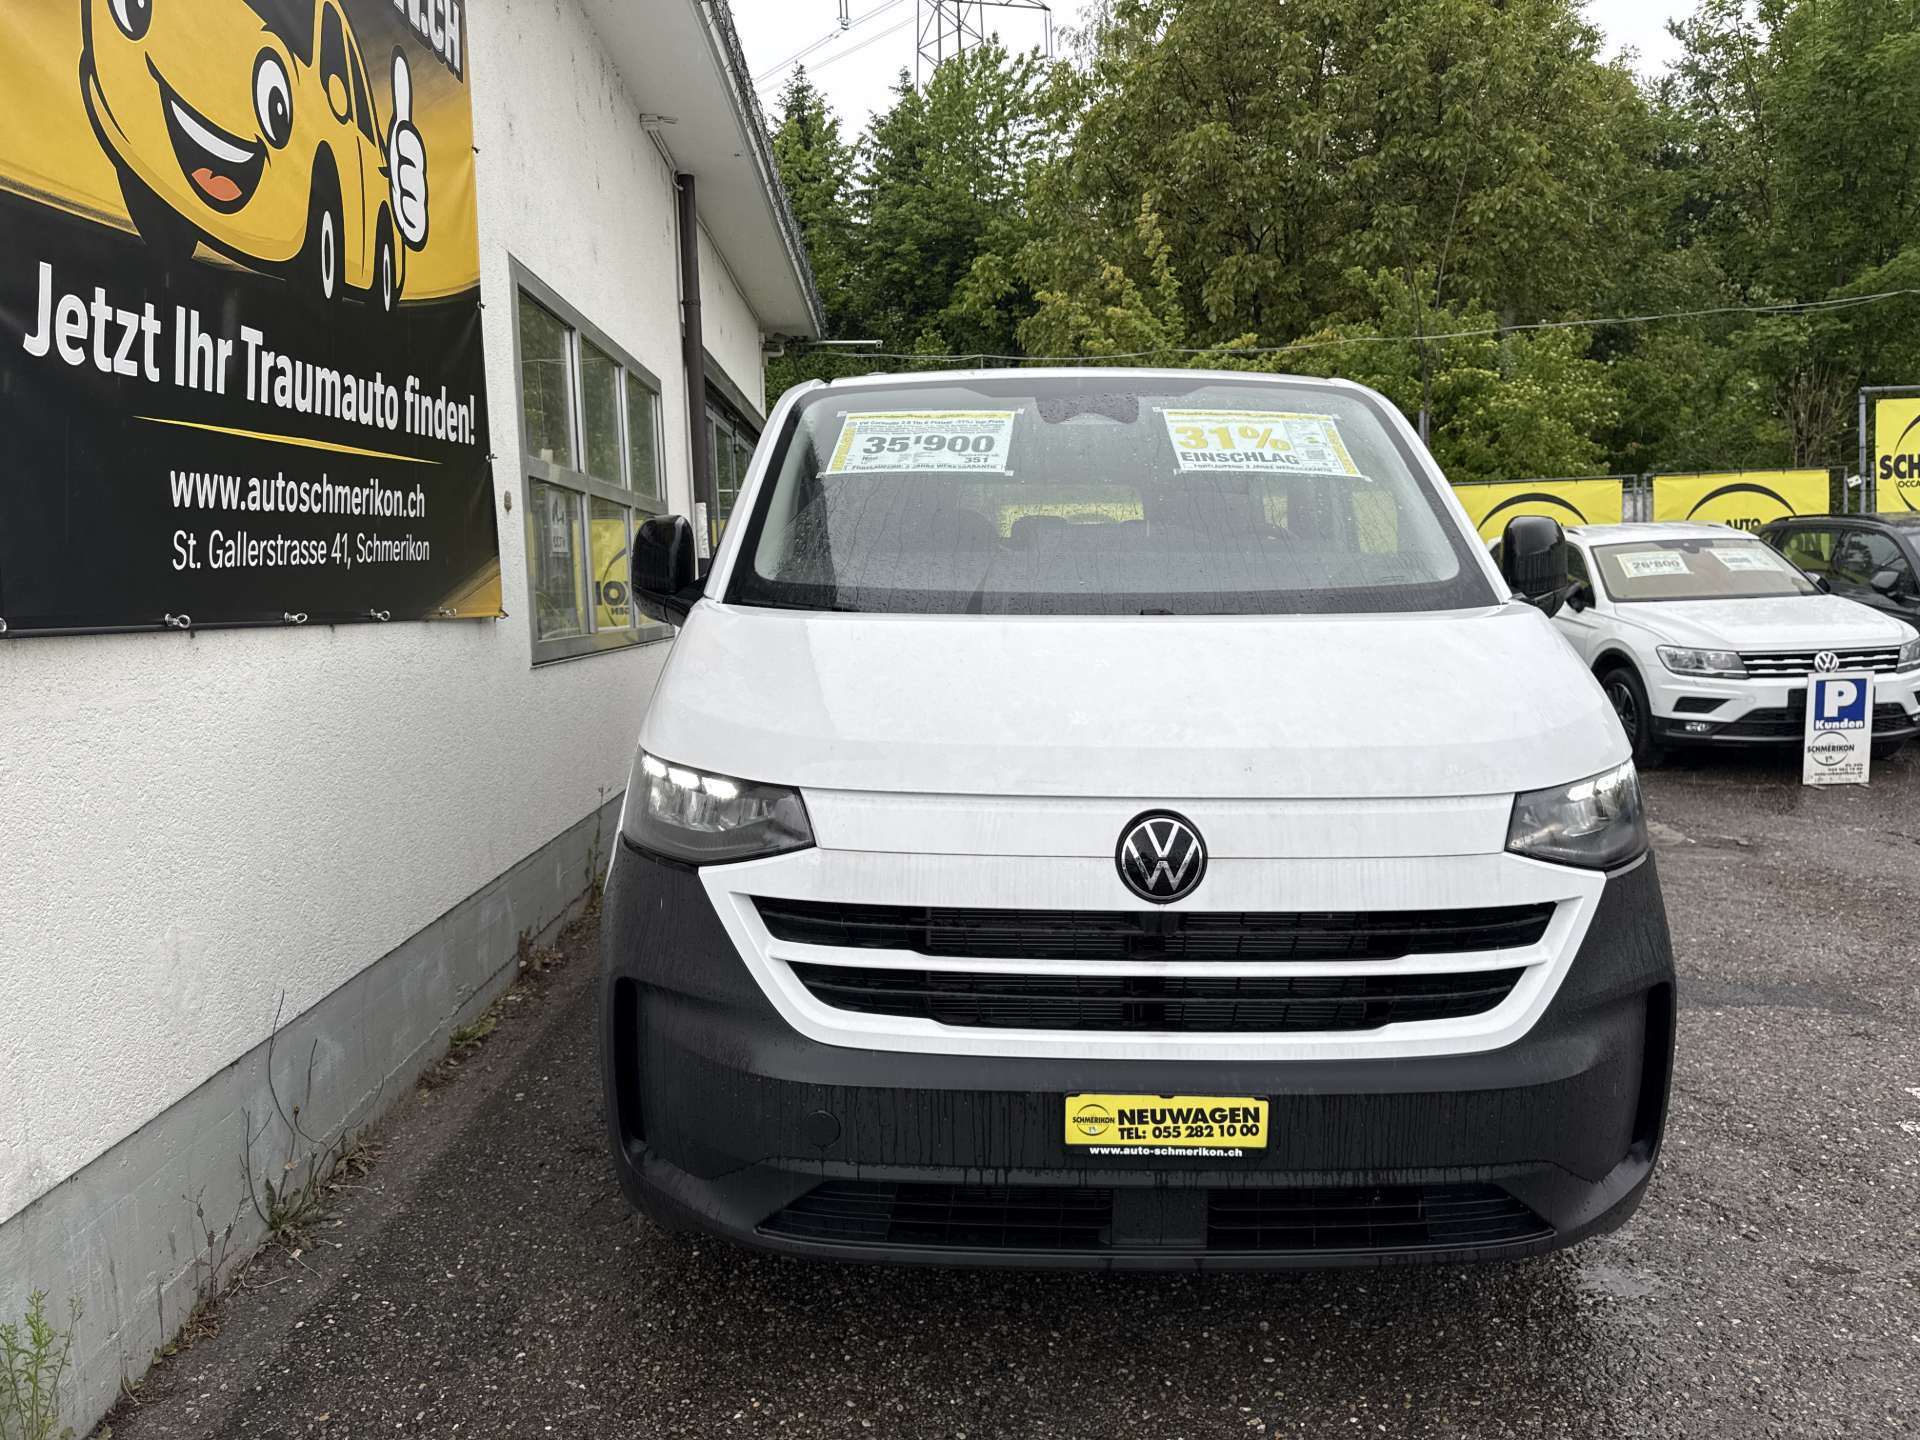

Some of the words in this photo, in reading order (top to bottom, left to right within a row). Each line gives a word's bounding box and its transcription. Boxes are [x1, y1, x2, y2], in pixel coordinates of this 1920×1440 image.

[23, 261, 162, 382] Jetzt
[175, 305, 233, 395] Ihr
[240, 325, 399, 430] Traumauto
[404, 374, 475, 445] finden!
[863, 435, 995, 454] 35'900
[1175, 425, 1292, 451] 31%
[1180, 451, 1300, 465] EINSCHLAG
[170, 470, 425, 518] www.autoschmerikon.ch
[172, 530, 201, 570] St.
[208, 530, 327, 569] Gallerstrasse
[330, 532, 351, 570] 41,
[356, 532, 430, 563] Schmerikon
[1823, 680, 1858, 718] P
[1815, 718, 1864, 730] Kunden
[1807, 743, 1855, 753] SCHMERIKON
[1072, 1116, 1116, 1124] SCHMERIKON
[1118, 1107, 1260, 1125] NEUWAGEN
[1119, 1127, 1147, 1140] TEL:
[1152, 1126, 1181, 1139] 055
[1185, 1125, 1213, 1138] 282
[1218, 1124, 1238, 1137] 10
[1240, 1124, 1260, 1137] 00
[1090, 1146, 1243, 1157] www.auto-schmerikon.ch
